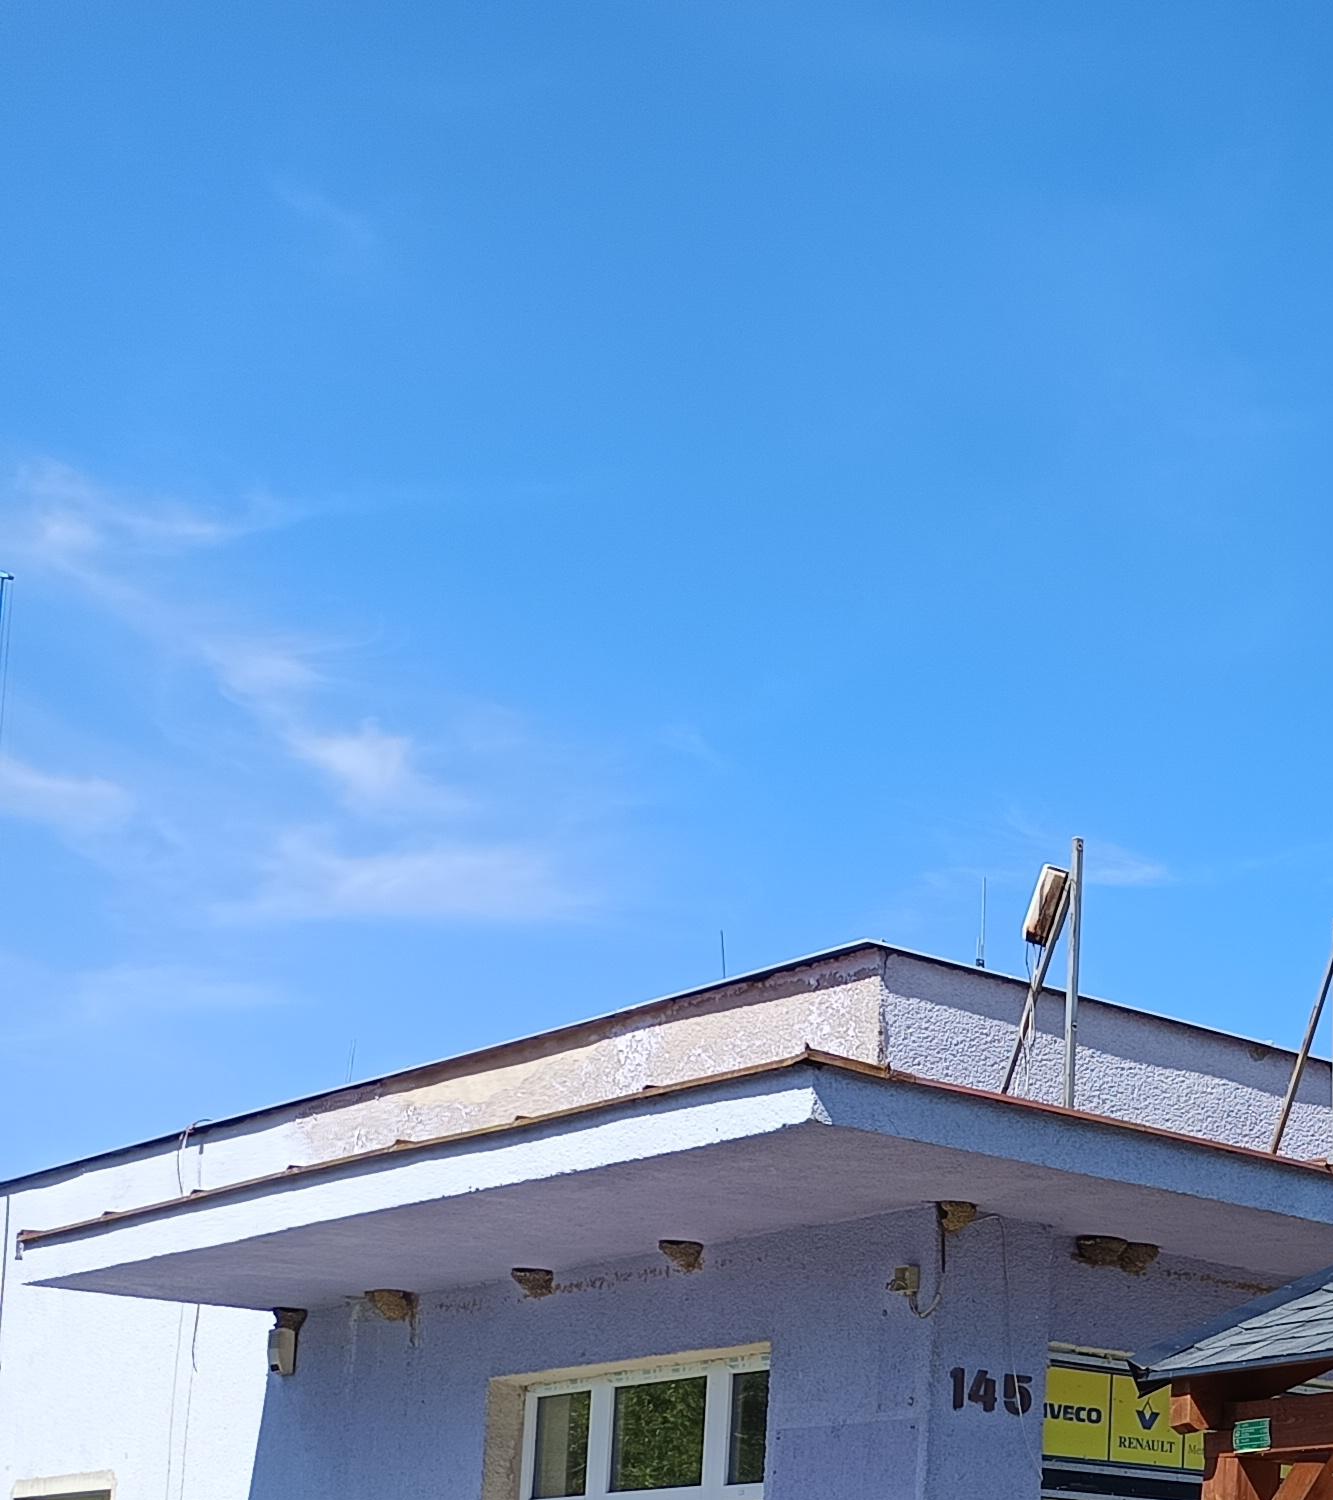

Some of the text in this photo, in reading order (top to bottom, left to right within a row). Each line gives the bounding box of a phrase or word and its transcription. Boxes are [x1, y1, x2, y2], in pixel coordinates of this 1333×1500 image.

[950, 1366, 1033, 1417] 145
[1043, 1402, 1102, 1424] IVECO
[1118, 1435, 1175, 1454] RENAULT
